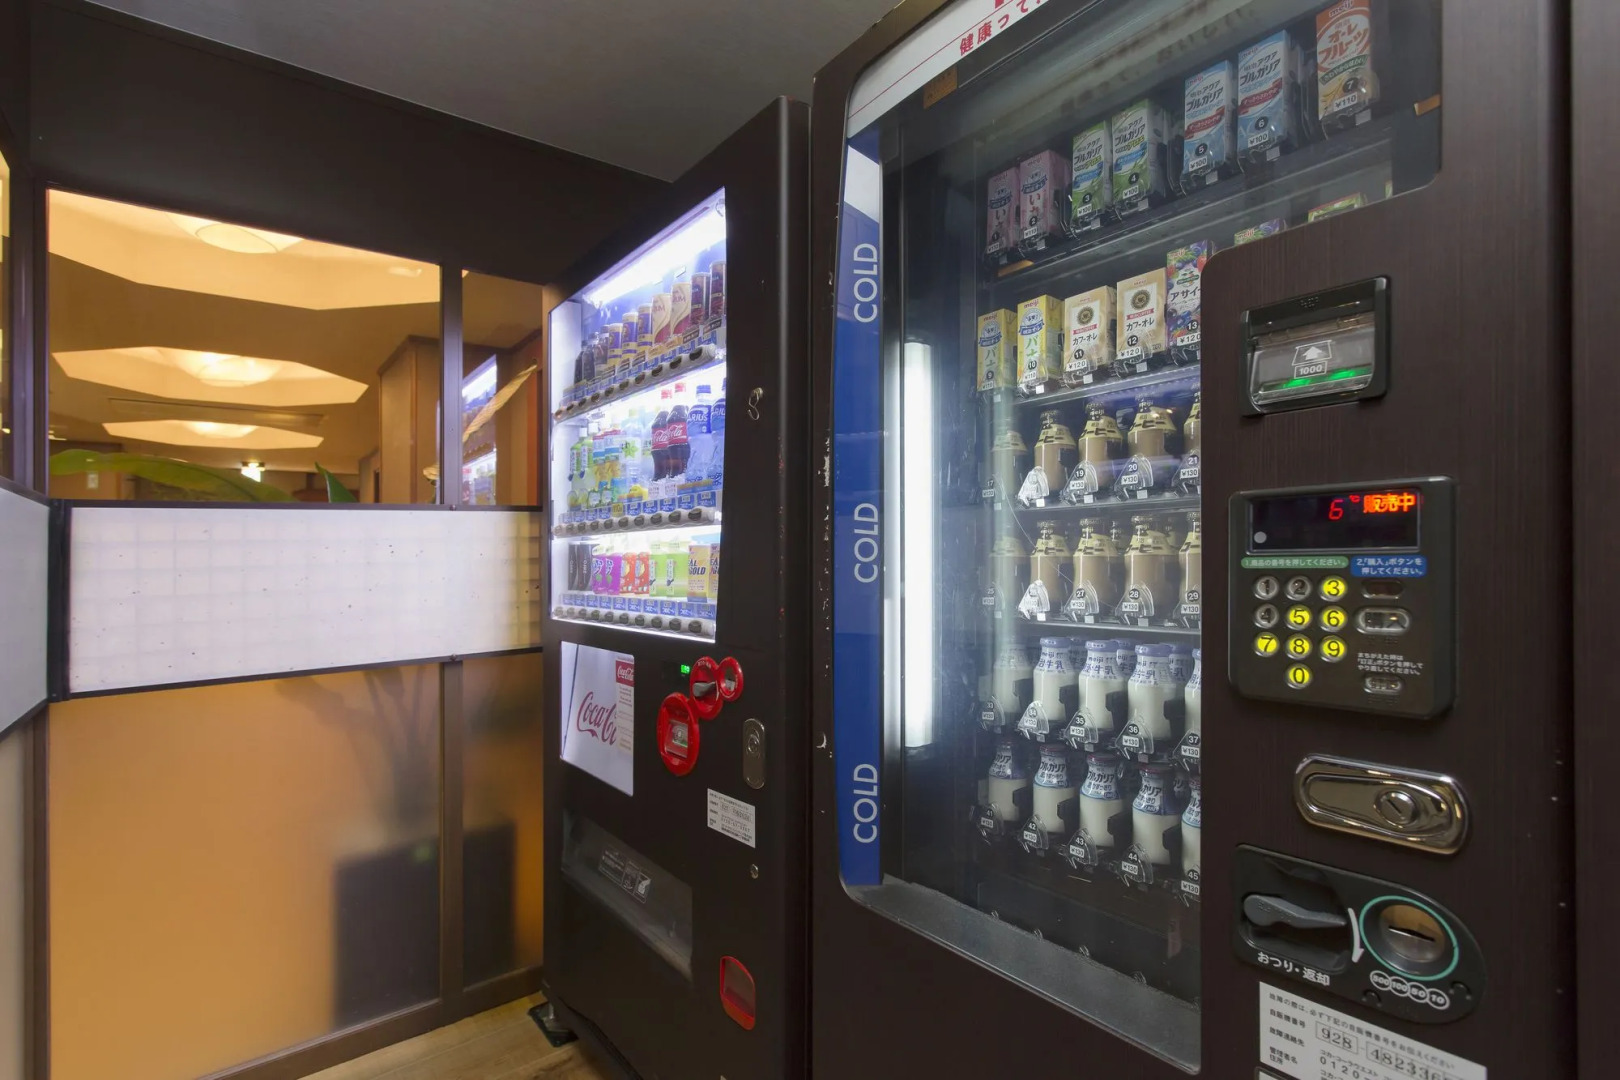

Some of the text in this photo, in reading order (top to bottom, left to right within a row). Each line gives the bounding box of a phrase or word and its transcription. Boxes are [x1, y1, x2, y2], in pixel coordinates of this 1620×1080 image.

[959, 0, 1043, 56] 健康って
[1318, 28, 1369, 65] フルーツ
[1240, 59, 1281, 86] ブルガリア
[1346, 80, 1354, 90] 7
[1186, 87, 1224, 112] ブルガリア
[1335, 95, 1357, 108] ¥110
[1258, 120, 1265, 128] 6
[1115, 124, 1146, 147] ブルガリア
[1249, 133, 1268, 145] ¥100
[1198, 145, 1205, 153] 5
[1074, 144, 1103, 165] ブルガリア
[1190, 158, 1207, 170] ¥100
[1131, 174, 1137, 182] 4
[1124, 187, 1138, 197] ¥100
[1031, 217, 1036, 225] 2
[853, 243, 878, 323] COLD
[1024, 299, 1039, 309] meiji
[1188, 321, 1197, 330] 13
[1075, 350, 1083, 358] 11
[1120, 348, 1140, 357] ¥120
[1068, 361, 1086, 369] ¥120
[1299, 364, 1323, 376] 1000
[1188, 456, 1198, 464] 21
[1182, 469, 1198, 477] ¥130
[1123, 475, 1138, 483] ¥130
[1071, 481, 1084, 489] ¥130
[1364, 493, 1417, 514] 販売中
[854, 503, 878, 583] COLD
[1263, 578, 1272, 596] 1
[1292, 578, 1306, 596] 2
[1326, 579, 1342, 597] 3
[1129, 590, 1139, 598] 28
[1188, 592, 1198, 600] 29
[1182, 605, 1199, 613] ¥130
[1260, 607, 1272, 624] 4
[1292, 609, 1306, 626] 5
[1326, 610, 1341, 628] 6
[1260, 636, 1273, 653] 7
[1292, 638, 1306, 656] 8
[1326, 640, 1341, 658] 9
[1293, 667, 1305, 685] 0
[1075, 717, 1085, 725] 35
[1071, 727, 1084, 735] ¥130
[1123, 738, 1138, 746] ¥130
[1188, 735, 1199, 743] 37
[1182, 748, 1199, 756] ¥130
[853, 763, 878, 843] COLD
[1075, 837, 1085, 845] 43
[1070, 847, 1084, 856] ¥130
[1128, 853, 1138, 861] 44
[1123, 863, 1138, 872] ¥130
[1188, 871, 1199, 880] 45
[1182, 883, 1199, 893] ¥130
[1257, 951, 1330, 987] おつり・返却
[1373, 973, 1446, 1005] 500 100 50 10
[1321, 1027, 1463, 1080] 928 482336
